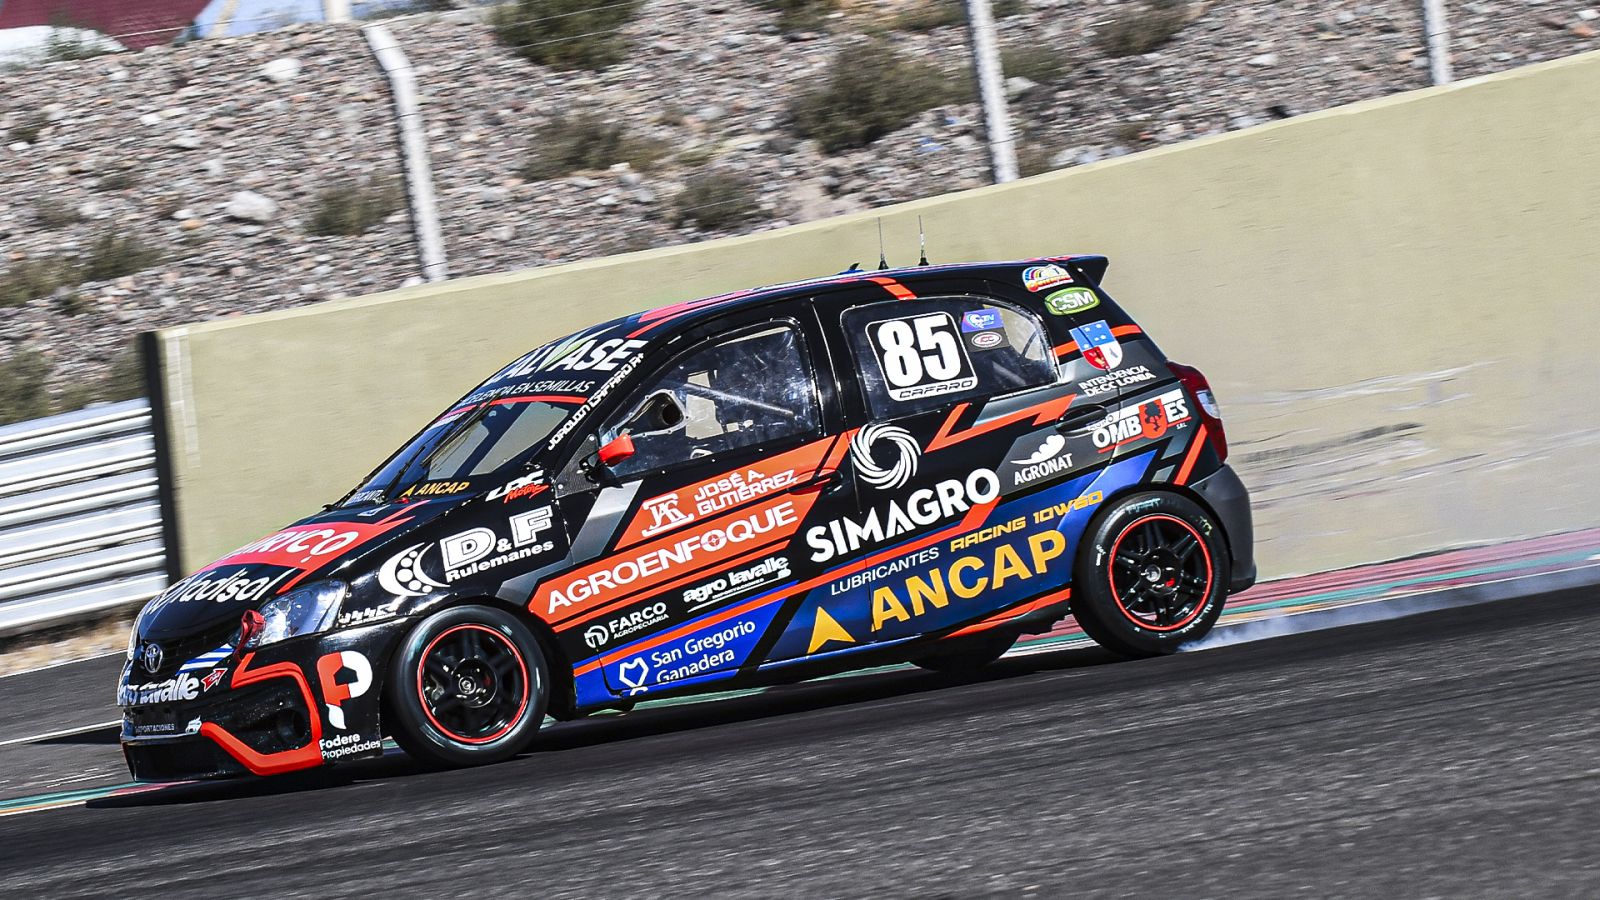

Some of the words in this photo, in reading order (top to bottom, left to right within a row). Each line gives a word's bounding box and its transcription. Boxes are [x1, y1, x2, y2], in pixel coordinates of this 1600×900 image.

[877, 314, 961, 387] 85
[513, 381, 534, 394] EN
[528, 380, 596, 393] SEMILLAS
[899, 380, 973, 398] CAFARO
[1078, 365, 1150, 389] INTENDENCIA
[414, 481, 471, 496] ANCAP
[693, 472, 745, 501] JOSÉ
[1014, 453, 1073, 485] AGRONAT
[696, 469, 798, 516] GUTIÉRREZ
[806, 467, 1000, 563] SIMAGRO
[950, 516, 1026, 553] RACING
[1033, 490, 1103, 524] 10W60
[439, 505, 553, 572] D&F
[547, 501, 798, 615] AGROENFOQUE
[445, 540, 554, 583] Rulemanes
[683, 578, 727, 602] agro
[728, 557, 789, 586] lavalle
[831, 547, 940, 596] LUBRICANTES
[871, 529, 1066, 632] ANCAP
[609, 602, 667, 633] FARCO
[613, 614, 669, 639] AGROPECUARIA
[651, 649, 682, 668] San
[684, 621, 756, 651] Gregorio
[656, 649, 735, 684] Ganadera
[319, 733, 361, 750] Fodere
[321, 740, 381, 759] Propiedades
